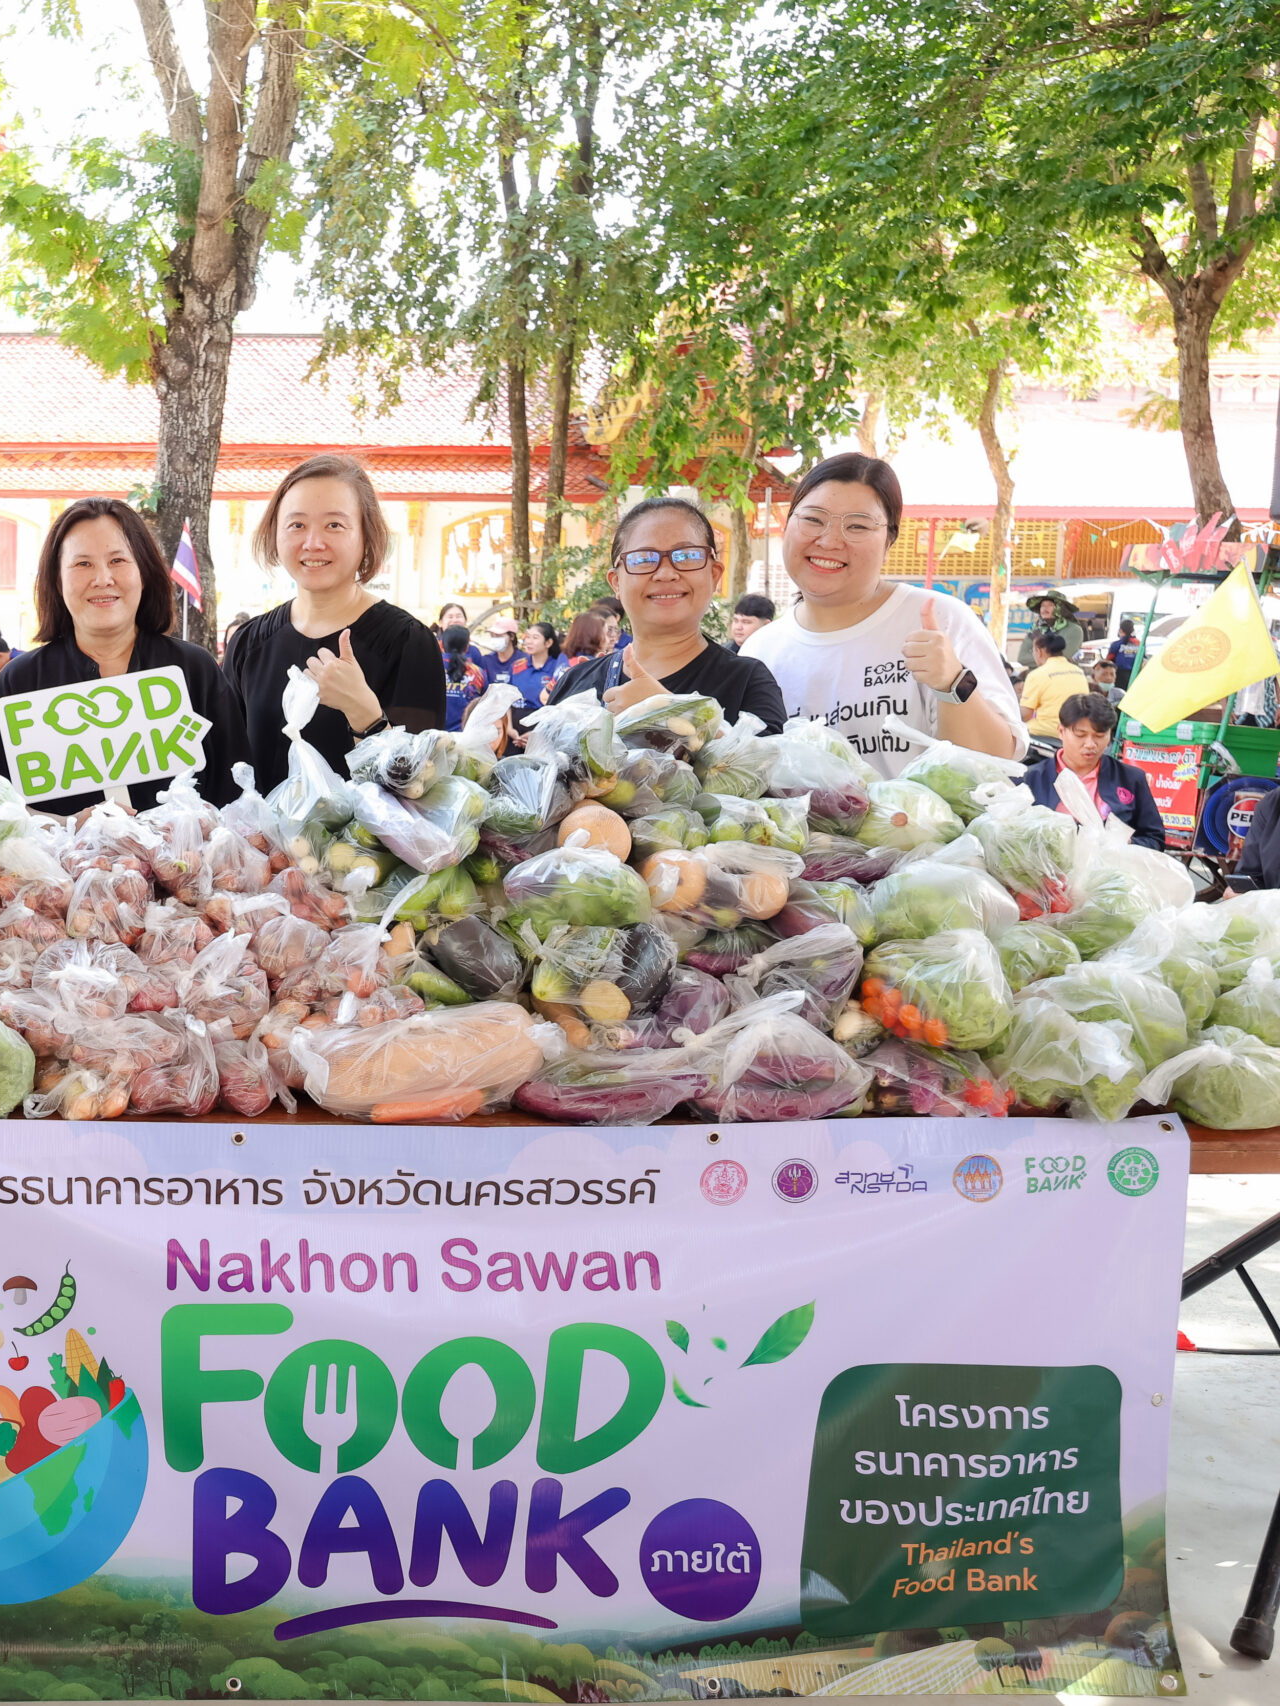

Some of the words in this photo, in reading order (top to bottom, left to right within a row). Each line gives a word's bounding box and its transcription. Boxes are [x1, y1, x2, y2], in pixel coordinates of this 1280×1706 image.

[4, 675, 182, 746] FOOD
[15, 726, 197, 797] BANK
[1025, 1155, 1087, 1174] FOOD
[302, 1168, 661, 1207] จังหวัดนครสวรรค์
[851, 1180, 928, 1194] NSTDA
[1026, 1174, 1082, 1194] BANK
[166, 1238, 419, 1294] Nakhon
[441, 1238, 661, 1293] Sawan
[160, 1303, 666, 1474] FOOD
[895, 1394, 1050, 1431] โครงการ
[854, 1446, 1079, 1480] ธนาคารอาหาร
[839, 1486, 1090, 1527] ของประเทศไทย
[191, 1466, 631, 1615] BANK
[650, 1543, 751, 1574] ภายใต้
[901, 1531, 1034, 1567] Thailand's
[893, 1570, 954, 1599] Food
[966, 1565, 1038, 1593] Bank
